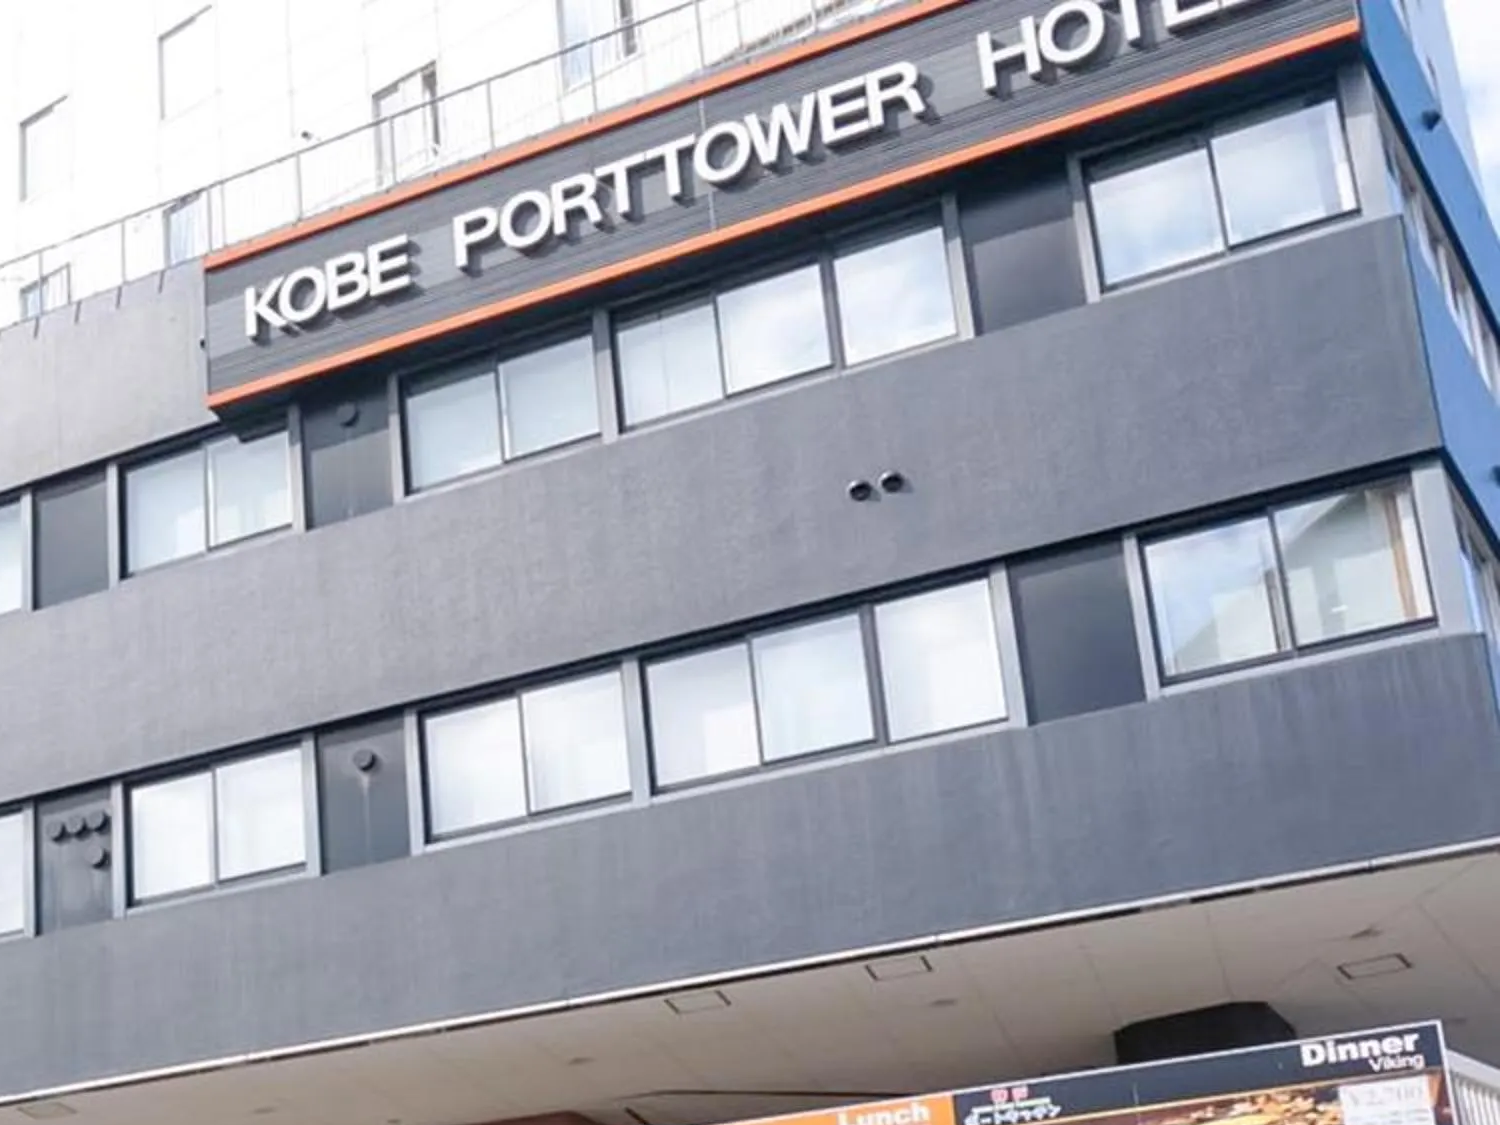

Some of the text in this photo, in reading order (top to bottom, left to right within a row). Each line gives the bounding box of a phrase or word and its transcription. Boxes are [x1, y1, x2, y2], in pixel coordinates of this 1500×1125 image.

[244, 0, 1252, 337] KOBE PORTTOWER HOT
[1301, 1033, 1420, 1067] Dinner
[1368, 1054, 1426, 1072] Viking
